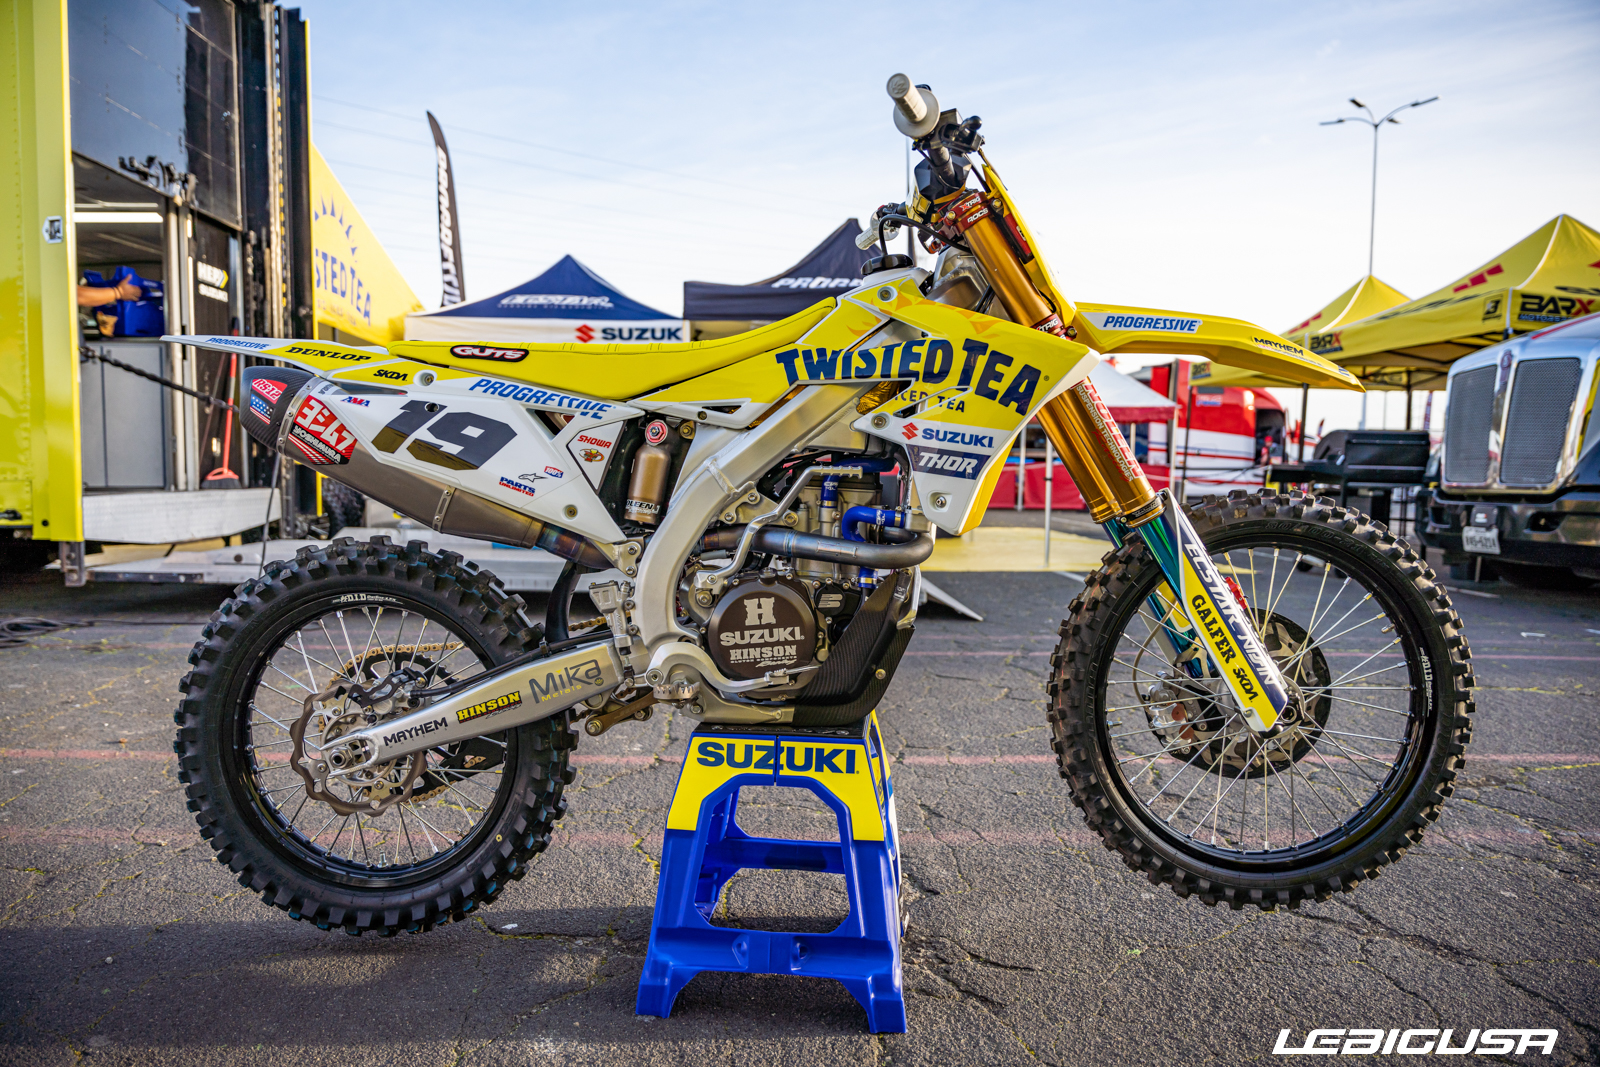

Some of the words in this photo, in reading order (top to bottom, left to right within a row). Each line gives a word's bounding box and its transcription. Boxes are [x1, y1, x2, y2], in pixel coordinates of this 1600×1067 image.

[959, 196, 981, 211] XTRIG
[967, 208, 989, 223] ROCS
[349, 265, 372, 327] TEA
[1520, 294, 1596, 317] BARX
[1103, 315, 1199, 332] PROGRESSIVE
[205, 337, 270, 350] PROGRESSIVE
[1254, 337, 1304, 356] MAYHEM
[1310, 330, 1343, 350] BARX
[285, 346, 372, 362] DUNLOP
[452, 346, 525, 360] GUTS
[373, 369, 408, 382] SKDA
[775, 339, 954, 387] TWISTED
[956, 338, 1042, 416] TEA
[340, 396, 370, 407] AMA
[469, 378, 612, 420] PROGRESSIVE
[937, 396, 965, 413] TEA
[371, 399, 518, 471] 19
[921, 428, 994, 448] SUZUKI
[1077, 385, 1104, 430] SUSPENSION
[1101, 427, 1134, 482] TECHNOLOGIES
[1082, 383, 1145, 479] NOLEEN
[577, 435, 612, 449] SHOWA
[918, 452, 978, 474] THOR
[498, 481, 535, 497] UNLIMITED
[499, 477, 536, 494] PARTS
[1184, 543, 1241, 632] ECSTAR
[743, 597, 776, 626] H
[720, 627, 801, 646] SUZUKI
[1191, 594, 1236, 664] GALFER
[730, 645, 797, 660] HINSON
[1238, 634, 1276, 685] NISSIN
[528, 659, 602, 704] Mika
[541, 684, 582, 702] Metals
[456, 691, 521, 721] HINSON
[383, 716, 448, 746] MAYHEM
[696, 741, 856, 775] SUZUKI
